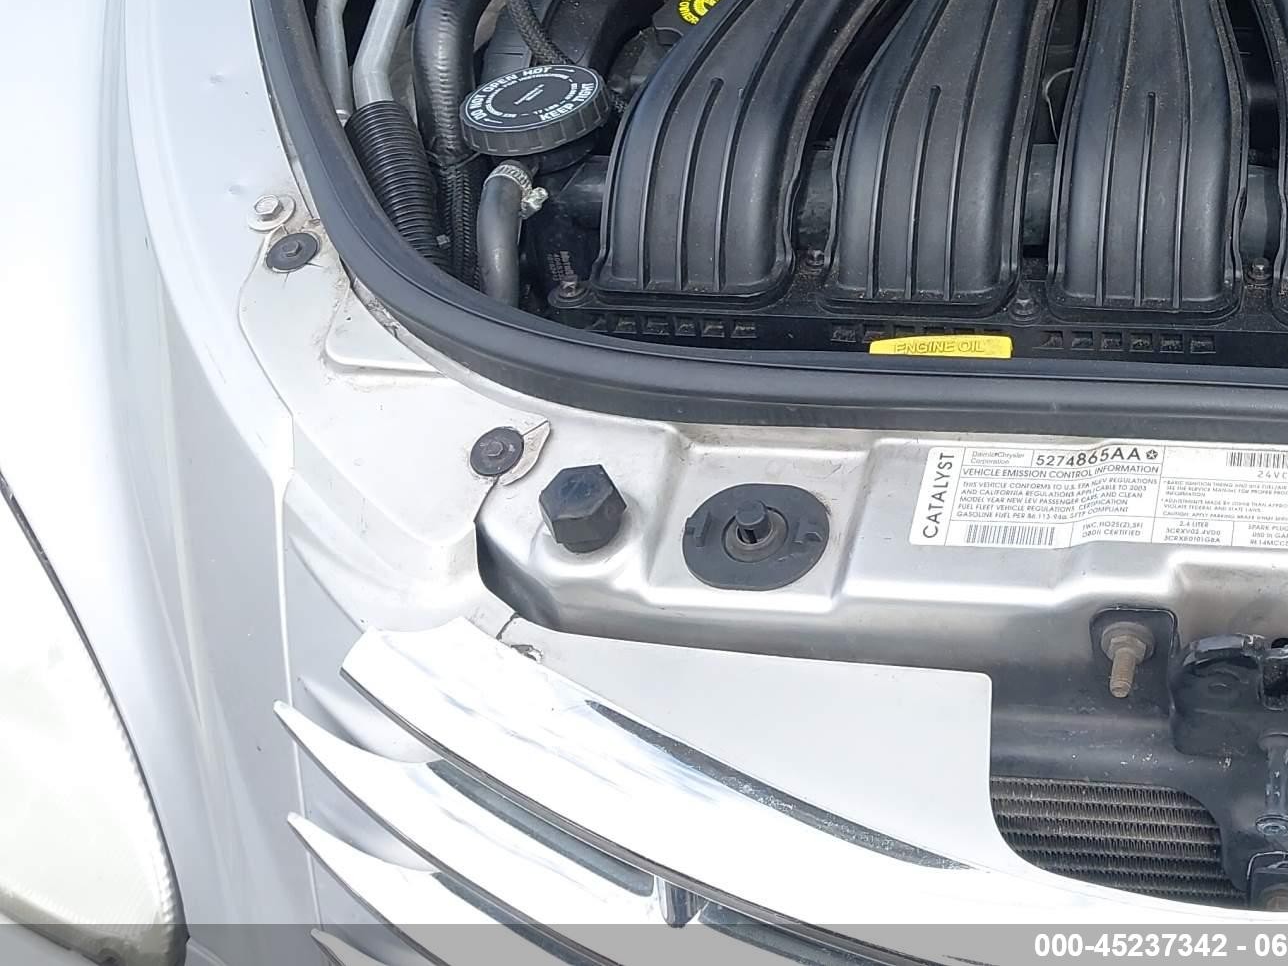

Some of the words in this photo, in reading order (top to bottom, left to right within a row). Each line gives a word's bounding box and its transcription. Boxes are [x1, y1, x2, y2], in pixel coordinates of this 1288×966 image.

[522, 67, 552, 76] HOT
[482, 74, 518, 93] OPEN
[469, 94, 486, 110] NOT
[539, 102, 575, 121] KEEP
[572, 82, 595, 103] TIGHT
[470, 108, 487, 120] DO
[895, 340, 955, 354] ENGINE
[957, 340, 985, 353] OIL
[1036, 446, 1141, 467] 5274865AA
[962, 467, 1002, 476] VEHICLE
[1002, 468, 1046, 478] EMISSION
[1049, 469, 1092, 479] CONTROL
[1095, 464, 1160, 476] INFORMATION
[1009, 482, 1051, 490] CONFORMS
[1109, 476, 1157, 485] REGULATIONS
[1025, 490, 1075, 498] REGULATIONS
[1077, 483, 1116, 496] APPLICABLE
[922, 451, 955, 539] CATALYST
[1087, 506, 1129, 515] COMPLIANT
